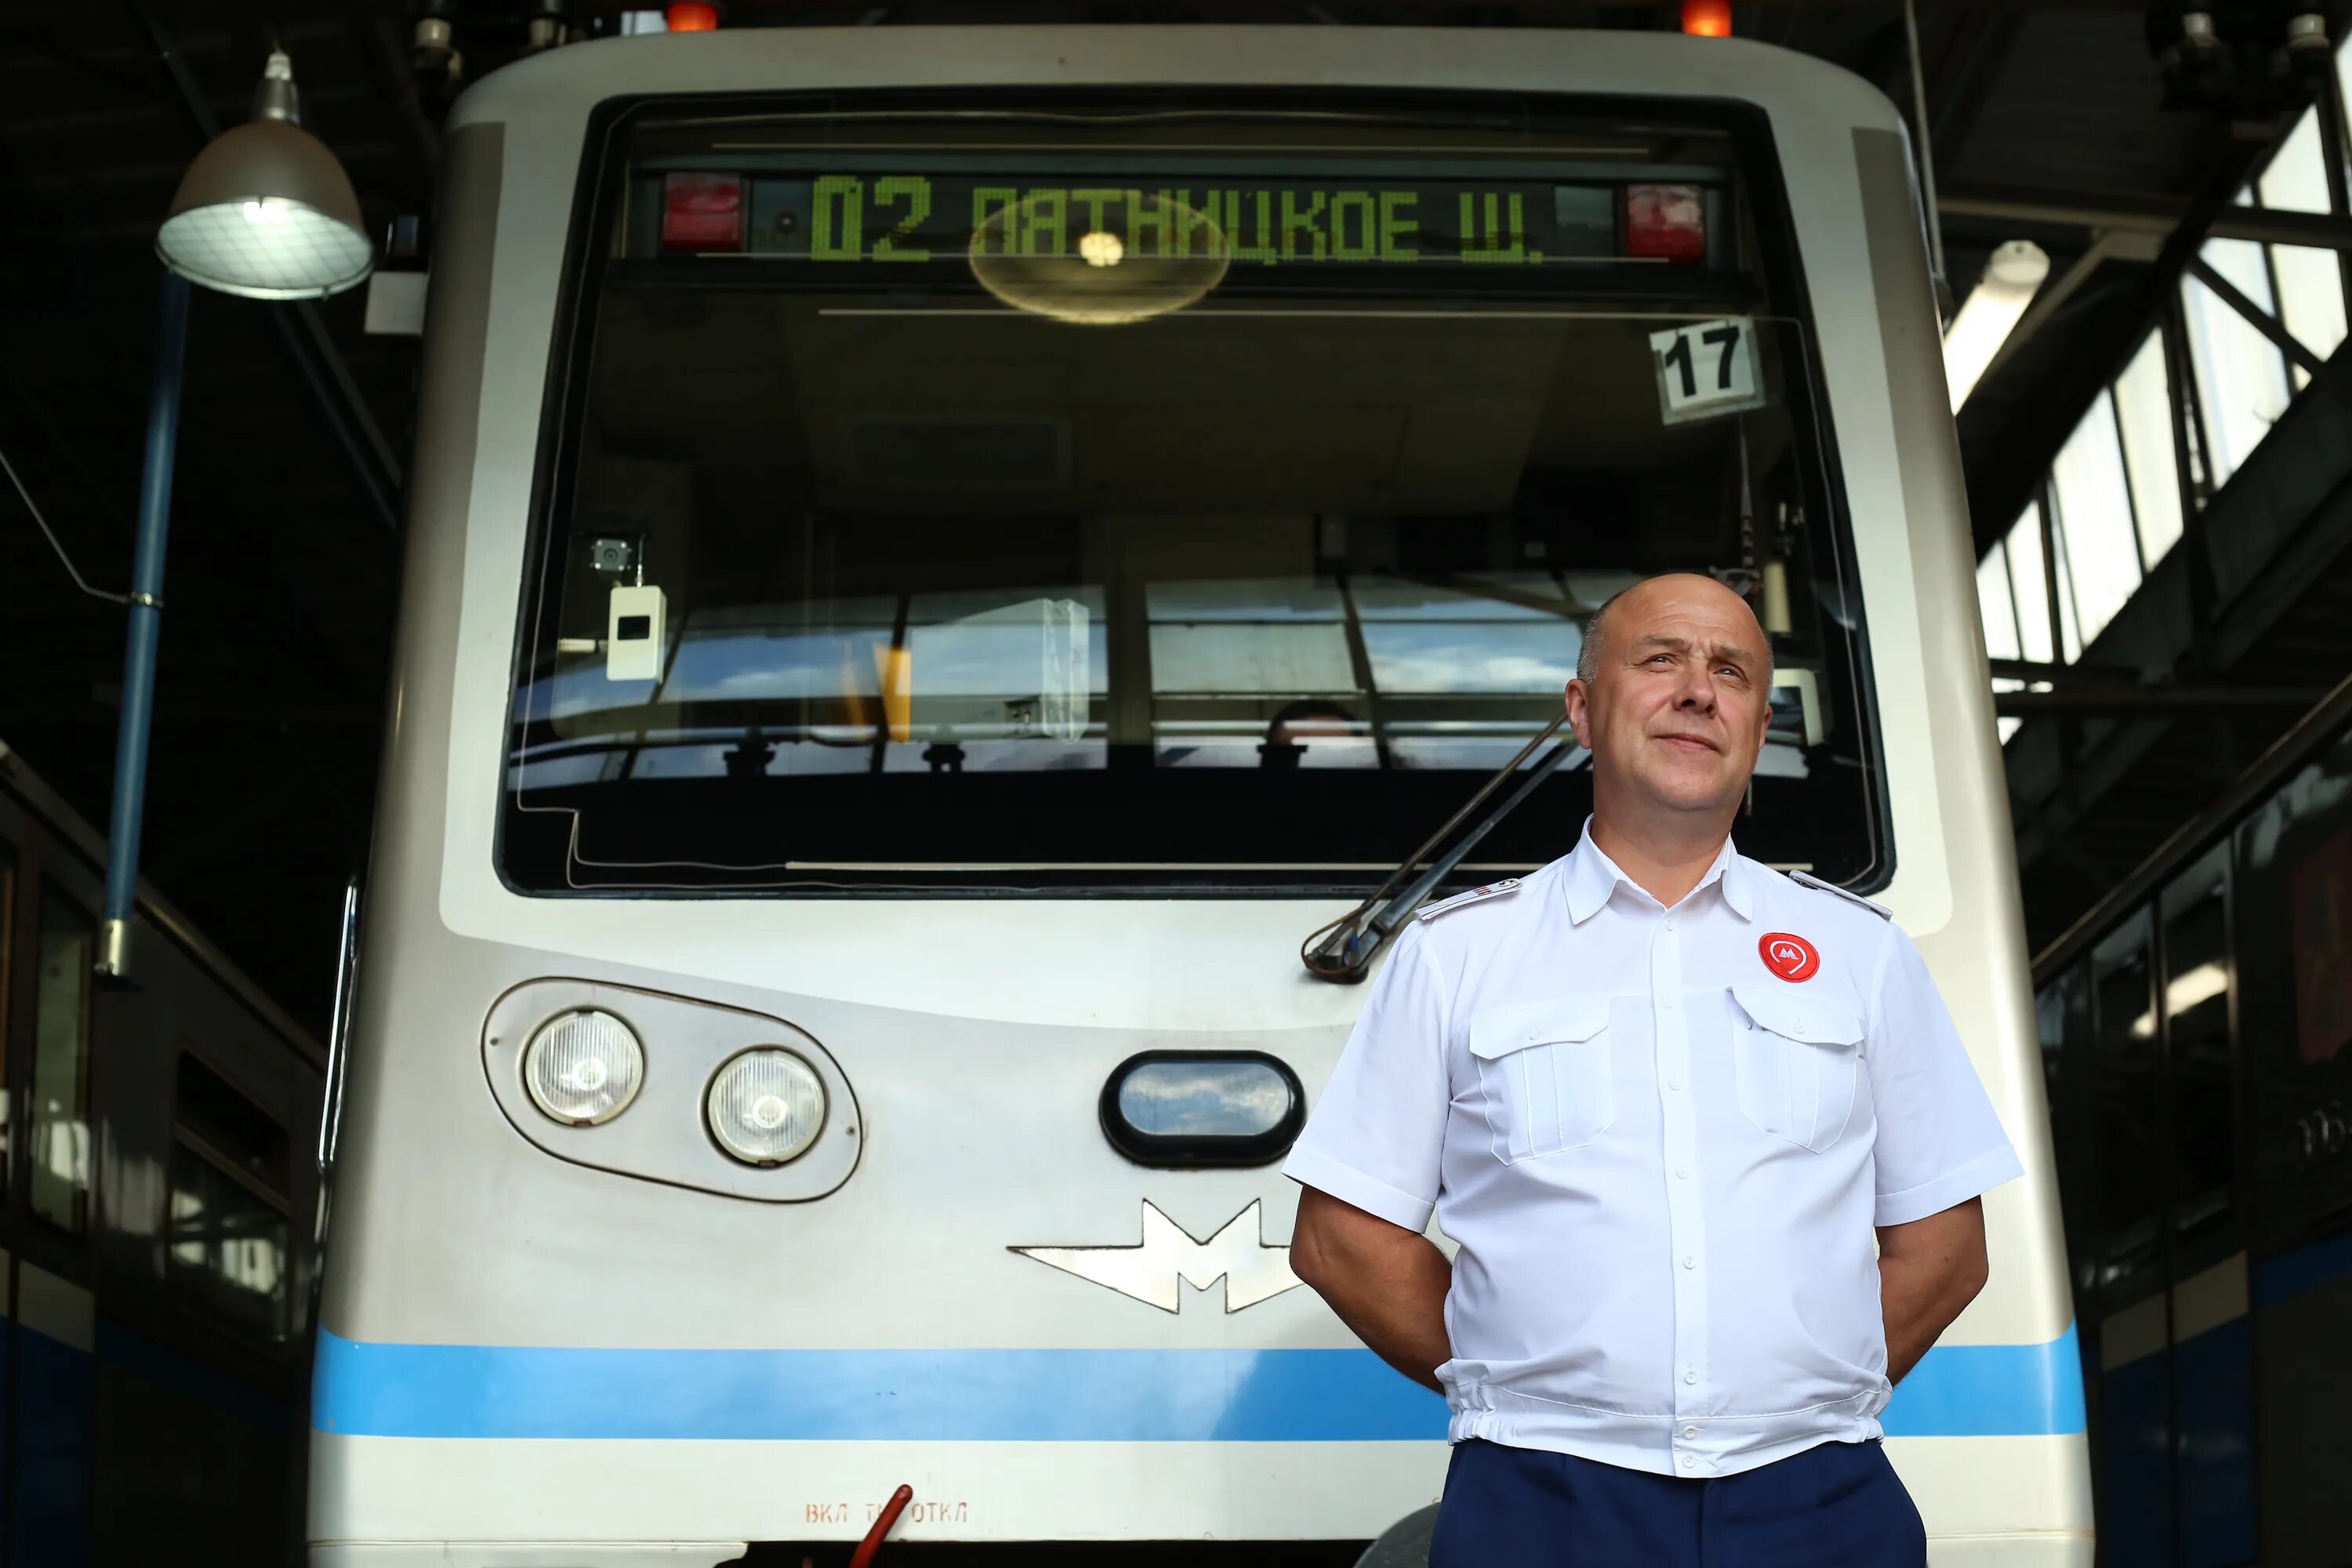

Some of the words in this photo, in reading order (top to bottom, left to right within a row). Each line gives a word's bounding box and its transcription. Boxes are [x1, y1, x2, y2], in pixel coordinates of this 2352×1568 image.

[811, 176, 931, 261] 02
[973, 188, 1419, 265] ПЯТНИЦКОЕ
[1460, 193, 1543, 263] Ш.
[1665, 326, 1740, 397] 17
[806, 1503, 848, 1523] ВКЛ
[912, 1501, 967, 1523] ОТКЛ
